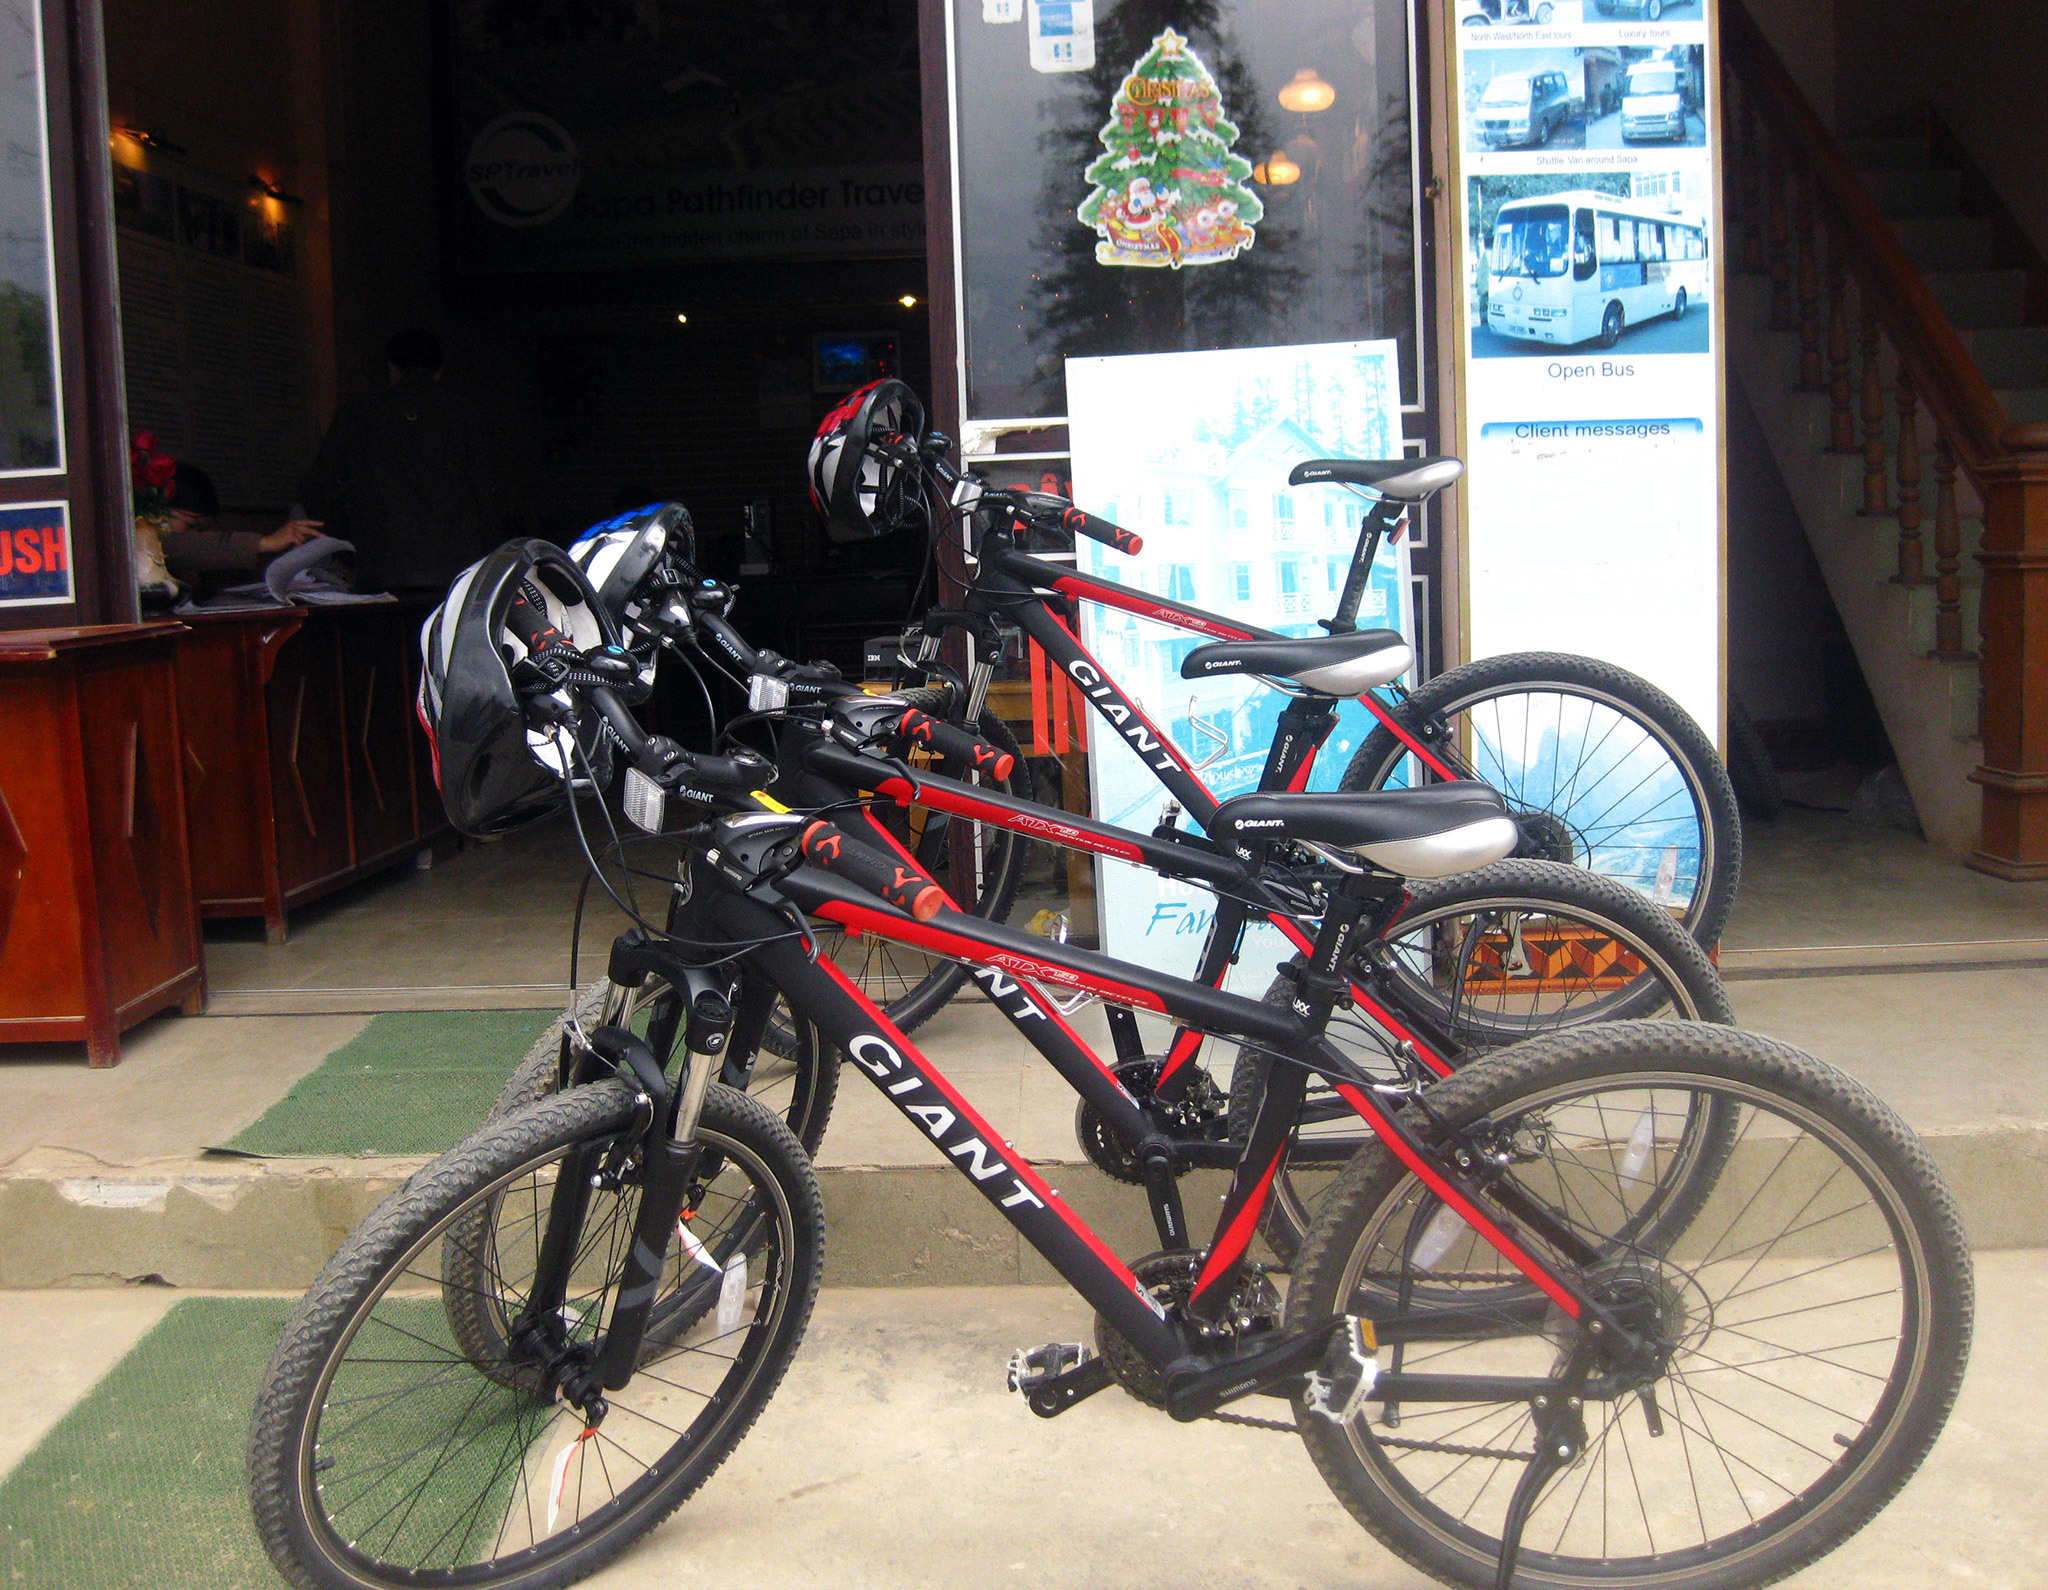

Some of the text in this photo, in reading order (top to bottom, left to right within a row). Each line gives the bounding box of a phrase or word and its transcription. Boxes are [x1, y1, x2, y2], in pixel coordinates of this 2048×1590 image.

[1619, 28, 1671, 39] Luxury tours
[1536, 154, 1638, 166] Shuttle Van around Sapa
[573, 179, 924, 223] Sapa Pathfinder Trave
[727, 226, 785, 245] charm
[790, 226, 810, 242] of
[814, 222, 862, 245] Sapa
[890, 220, 926, 244] styl
[1547, 362, 1635, 382] Open Bus
[1515, 422, 1671, 441] Client messages
[720, 638, 743, 663] GIANT
[867, 654, 881, 662] IBM
[1212, 659, 1242, 668] GIANT
[795, 684, 822, 694] GIANT
[1068, 660, 1183, 775] GIANT
[607, 725, 631, 756] GIANT
[1276, 741, 1290, 774] GIANT
[686, 790, 715, 804] GIANT
[1244, 818, 1285, 829] GIANT
[1326, 933, 1346, 972] GIANT
[985, 953, 1052, 978] ATX
[849, 1034, 1045, 1210] GIANT
